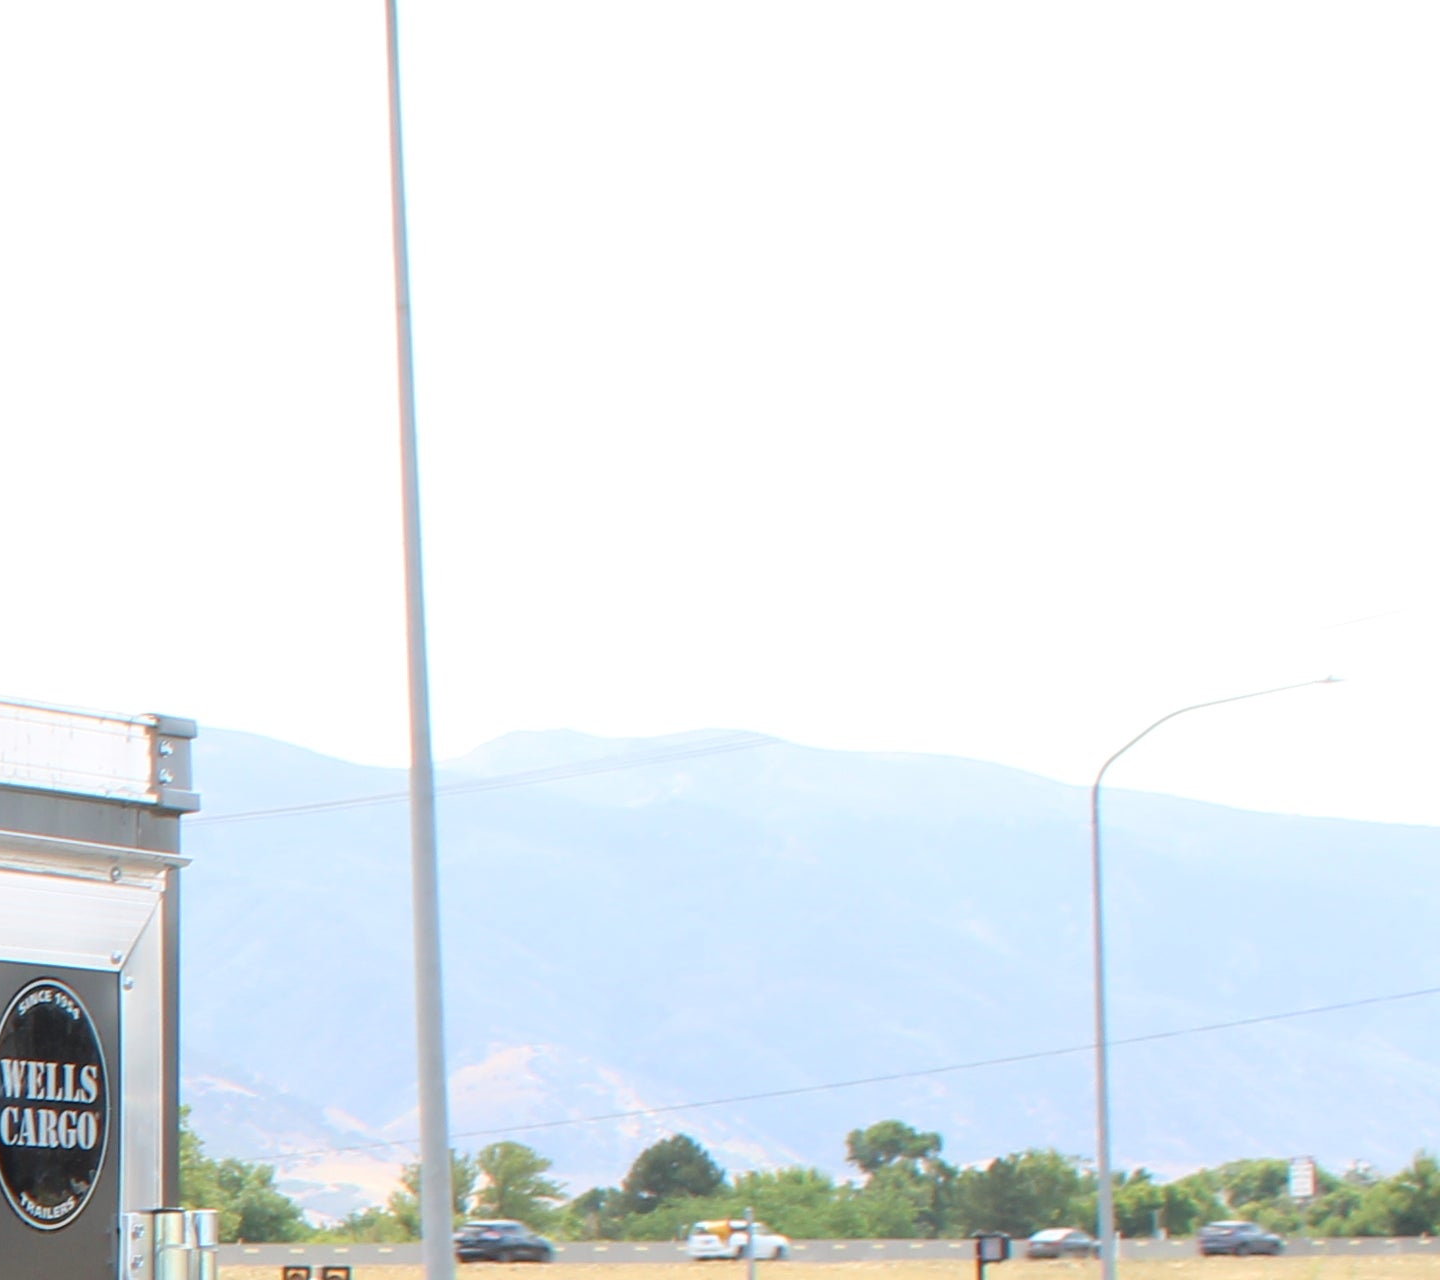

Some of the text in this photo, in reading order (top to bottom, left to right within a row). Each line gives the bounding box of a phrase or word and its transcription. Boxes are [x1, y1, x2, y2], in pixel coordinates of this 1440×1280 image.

[18, 990, 53, 1016] SINCE
[0, 1058, 98, 1104] WELLS
[0, 1106, 97, 1150] CARGO
[20, 1191, 75, 1219] TRAILERS
